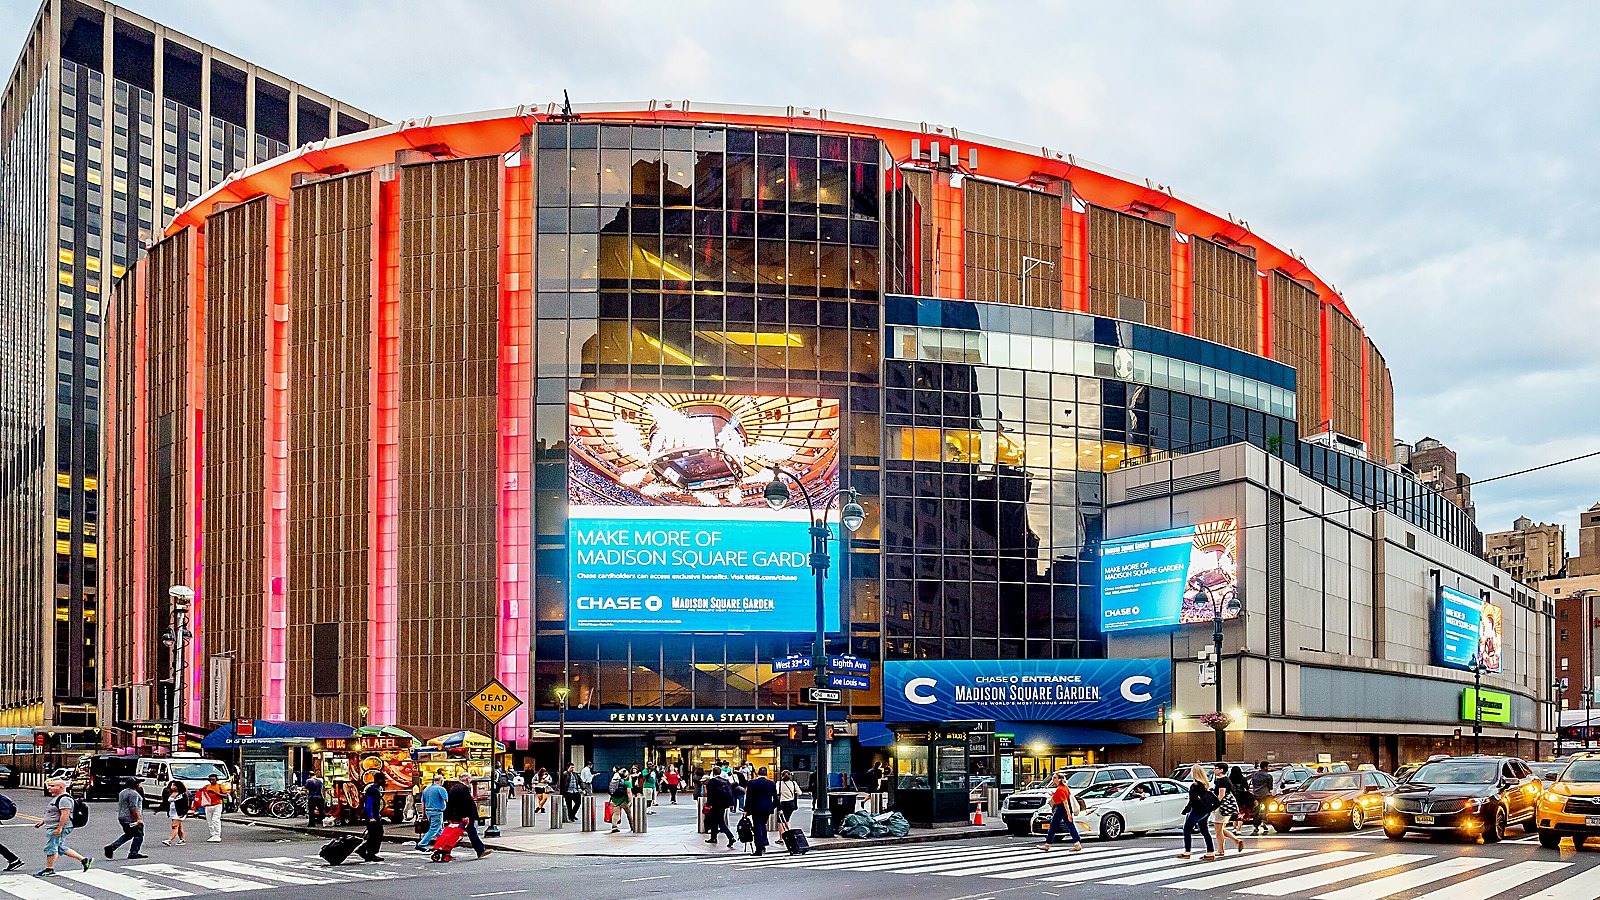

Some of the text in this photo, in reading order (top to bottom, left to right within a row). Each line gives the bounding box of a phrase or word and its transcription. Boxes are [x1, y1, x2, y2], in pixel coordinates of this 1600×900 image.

[577, 529, 722, 547] MAKE MORE OF
[577, 549, 813, 569] MADISON SQUARE GARDE
[1105, 566, 1120, 574] MAKE
[1122, 563, 1139, 571] MORE
[1105, 564, 1184, 580] MADISON SQUARE GARDEN
[576, 596, 643, 610] CHASE
[671, 596, 709, 609] MADISON
[710, 596, 741, 609] SQUARE
[1105, 608, 1132, 617] CHASE
[775, 658, 810, 670] West 33rd St
[832, 658, 867, 670] Eighth Ave
[832, 677, 842, 686] Joe
[842, 677, 858, 687] Louis
[1021, 675, 1082, 683] ENTRANCE
[480, 693, 508, 702] DEAD
[955, 685, 1006, 701] MADISON
[1009, 684, 1053, 702] SQUARE
[484, 704, 504, 712] END
[610, 713, 776, 721] PENNSYLVANIA STATION
[326, 739, 346, 749] HOT DOG
[359, 738, 399, 749] ALAFEL
